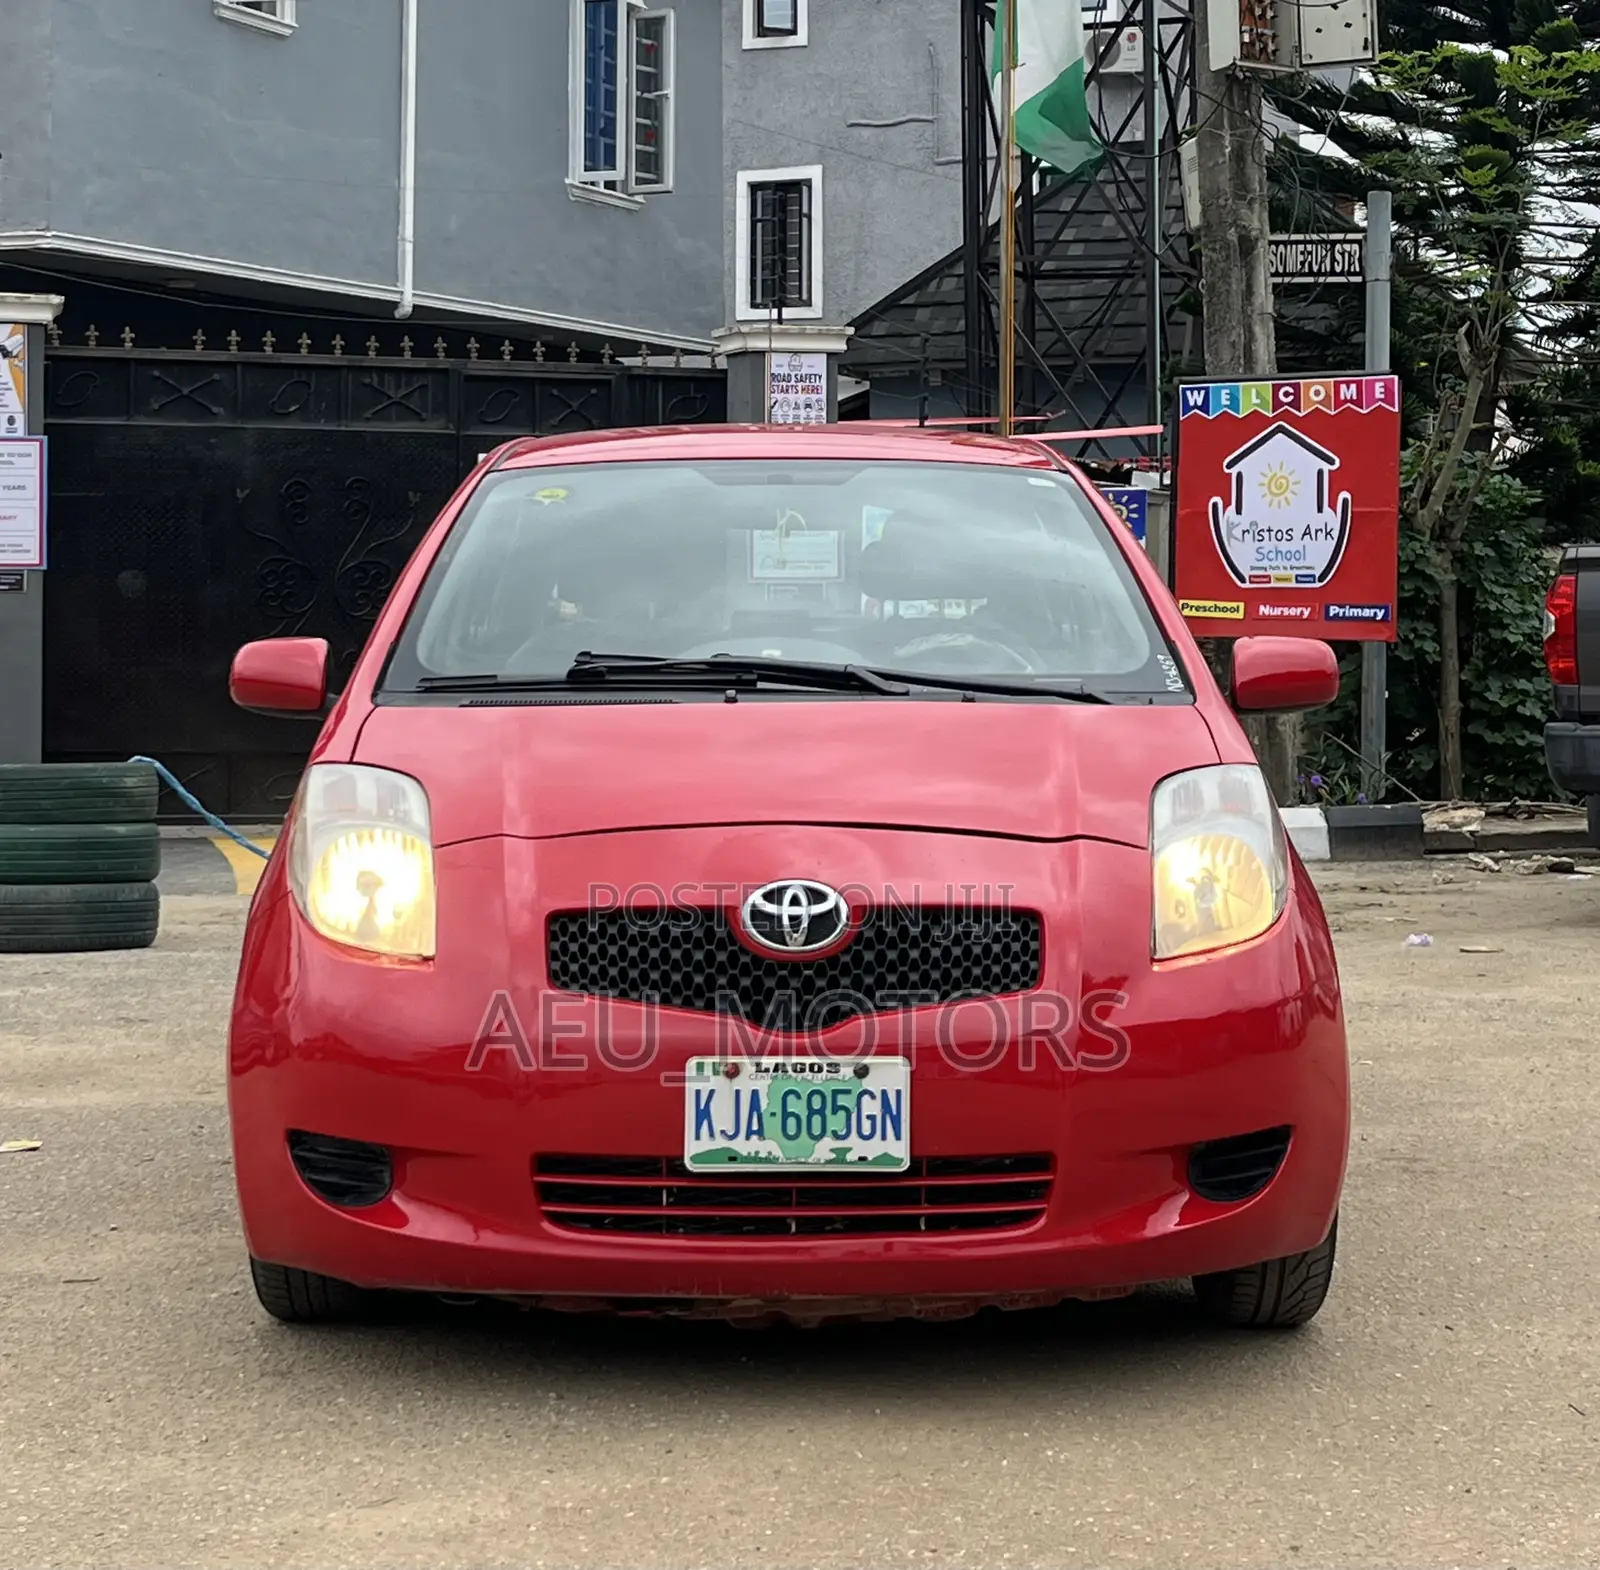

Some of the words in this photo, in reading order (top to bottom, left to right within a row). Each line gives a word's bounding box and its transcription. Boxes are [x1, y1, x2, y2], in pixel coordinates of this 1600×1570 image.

[1269, 244, 1331, 273] SOMEFUN
[1334, 243, 1360, 273] STR
[771, 372, 792, 383] ROAD
[794, 373, 823, 384] SAFETY
[771, 384, 799, 394] STARTS
[1185, 381, 1385, 407] WELCOME
[1226, 517, 1294, 547] Kristos
[1301, 522, 1335, 542] Ark
[1255, 544, 1307, 562] School
[1181, 602, 1240, 614] Preschool
[1258, 604, 1311, 619] Nursery
[1329, 605, 1386, 620] Primary
[754, 1062, 841, 1074] LAGOS
[694, 1088, 902, 1141] KJA-685GN
